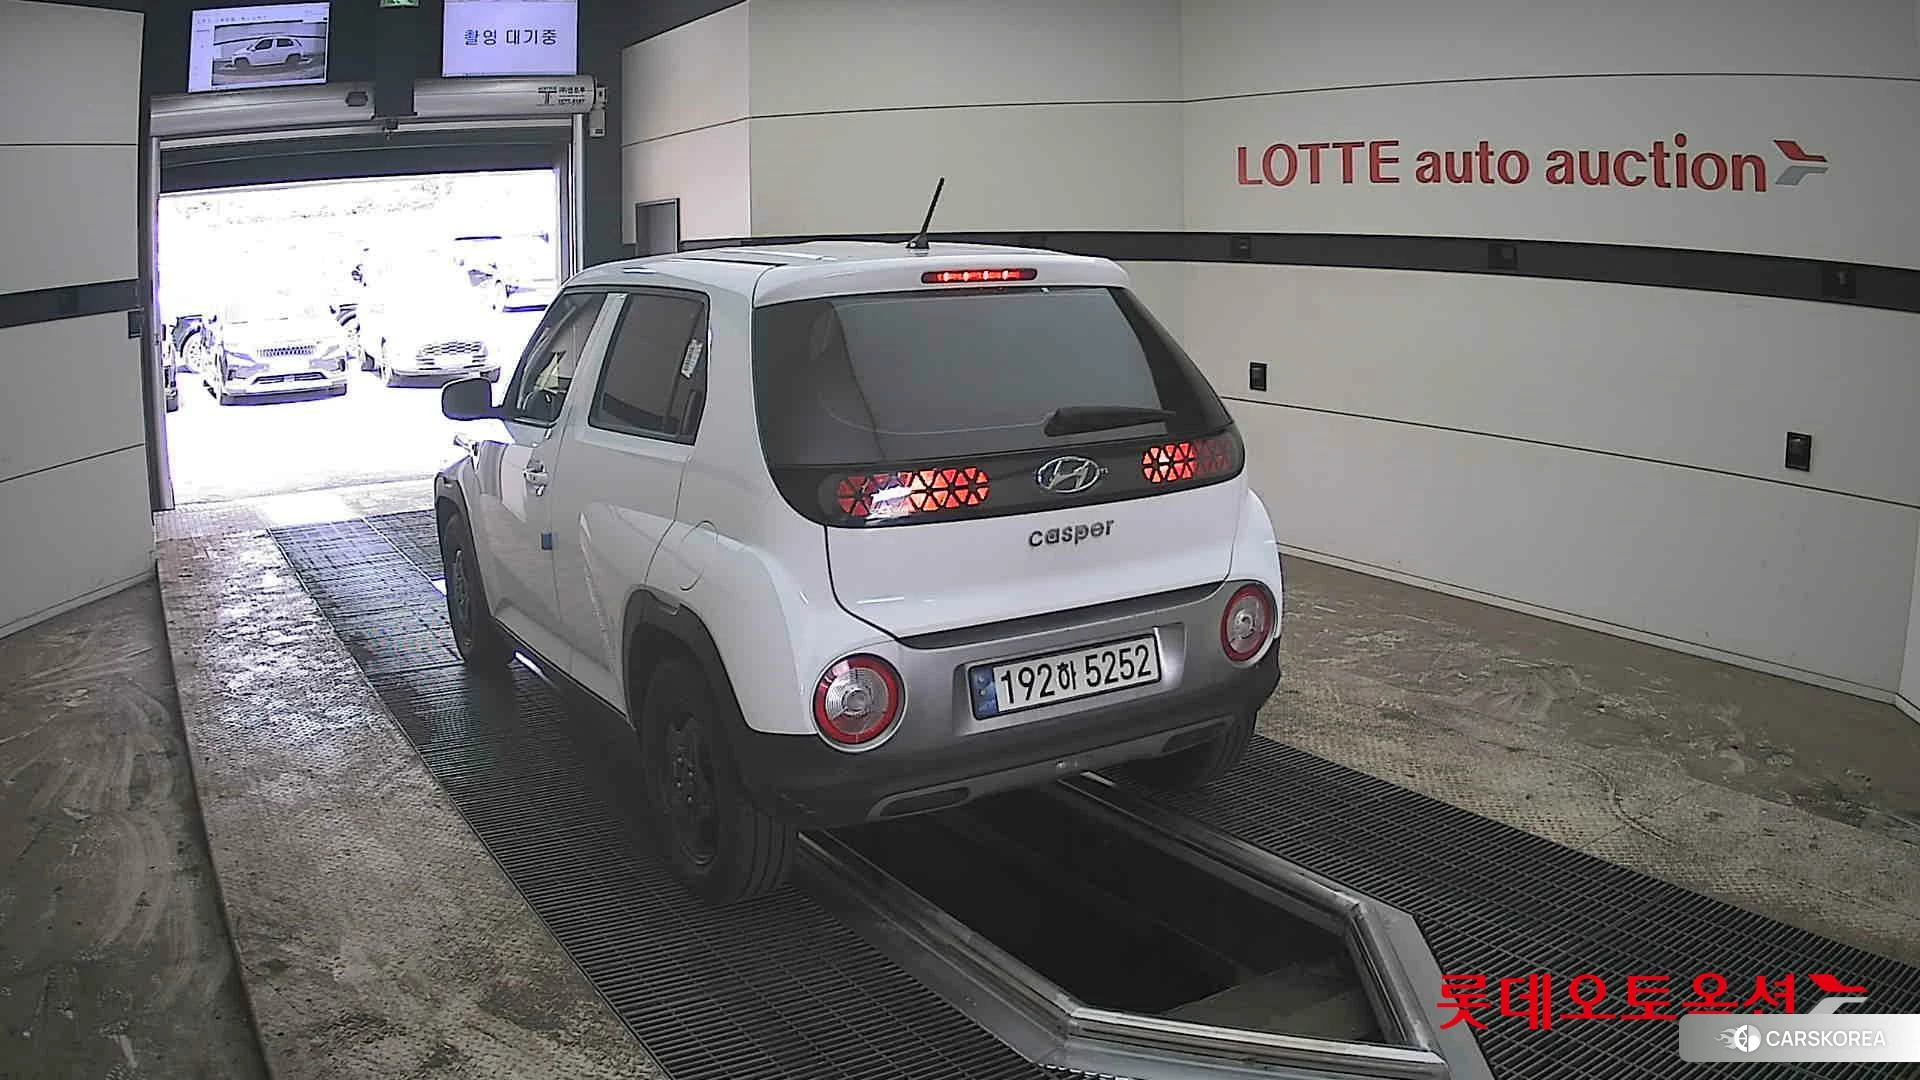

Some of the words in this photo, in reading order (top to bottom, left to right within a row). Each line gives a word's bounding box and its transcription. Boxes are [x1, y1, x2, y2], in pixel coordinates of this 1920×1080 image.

[506, 29, 557, 46] 대기중
[1237, 139, 1400, 186] LOTTE
[1415, 140, 1530, 186] auto
[1545, 133, 1768, 193] auction
[1028, 519, 1115, 548] casper
[1000, 659, 1077, 705] 192하
[1085, 644, 1152, 688] 5252
